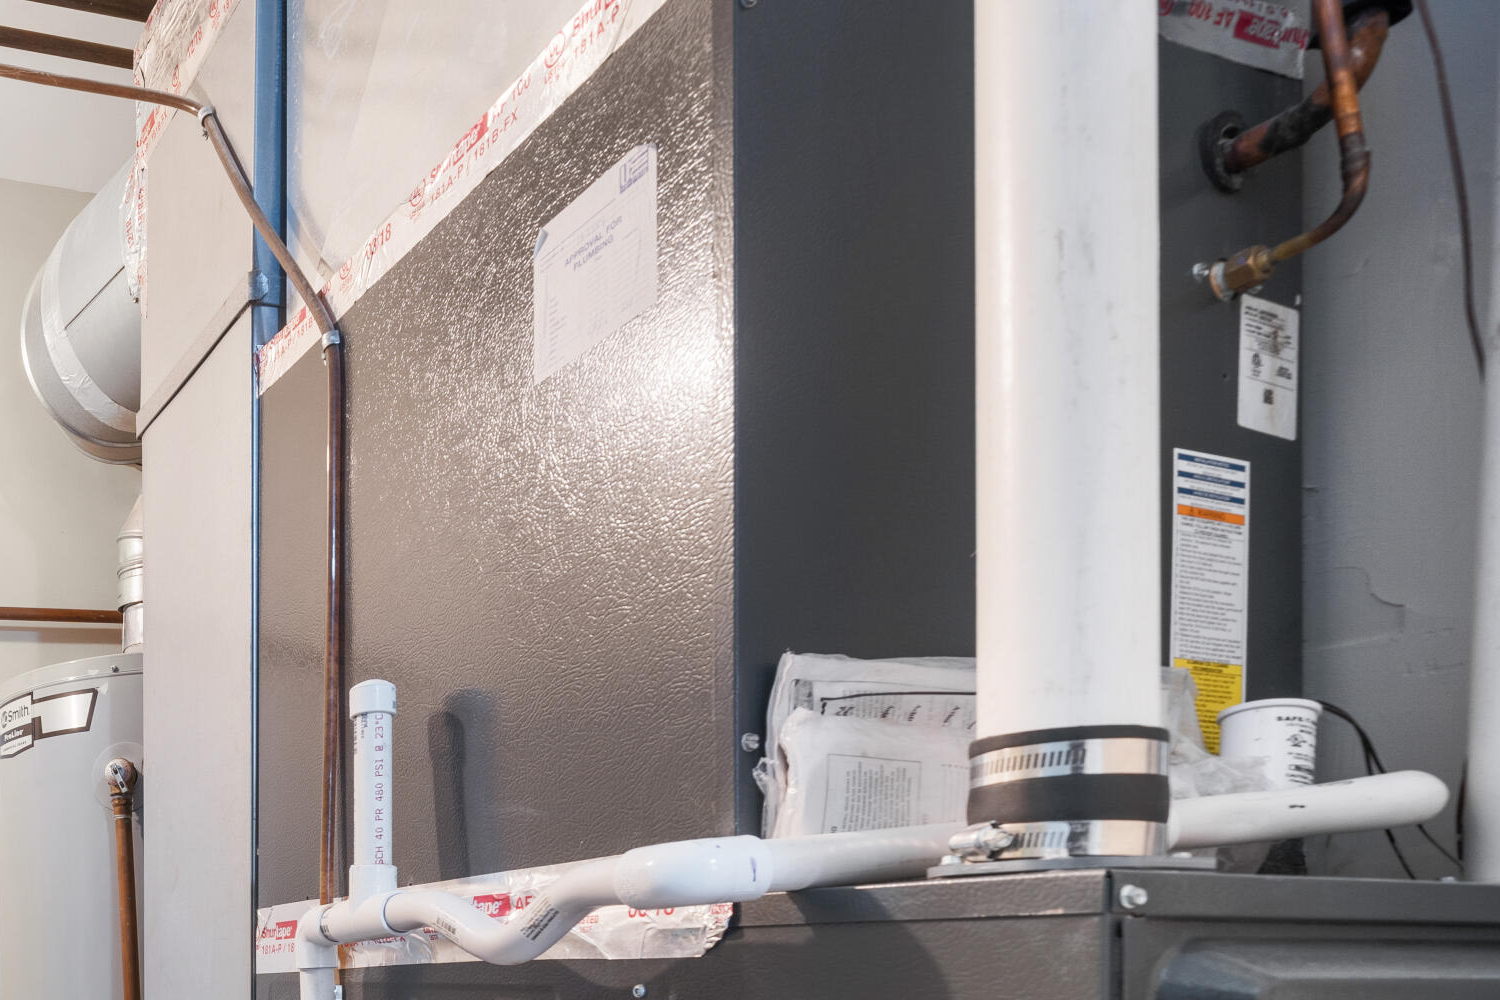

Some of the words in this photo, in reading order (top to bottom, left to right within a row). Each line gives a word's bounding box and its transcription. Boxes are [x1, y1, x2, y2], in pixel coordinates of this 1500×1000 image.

[564, 230, 603, 267] APPROVAL
[606, 215, 622, 234] FOR
[573, 234, 614, 272] PLUMBING
[375, 759, 384, 777] PSI
[375, 783, 384, 801] 480
[375, 808, 384, 821] PR
[375, 826, 384, 840] 40
[374, 846, 385, 865] SCH
